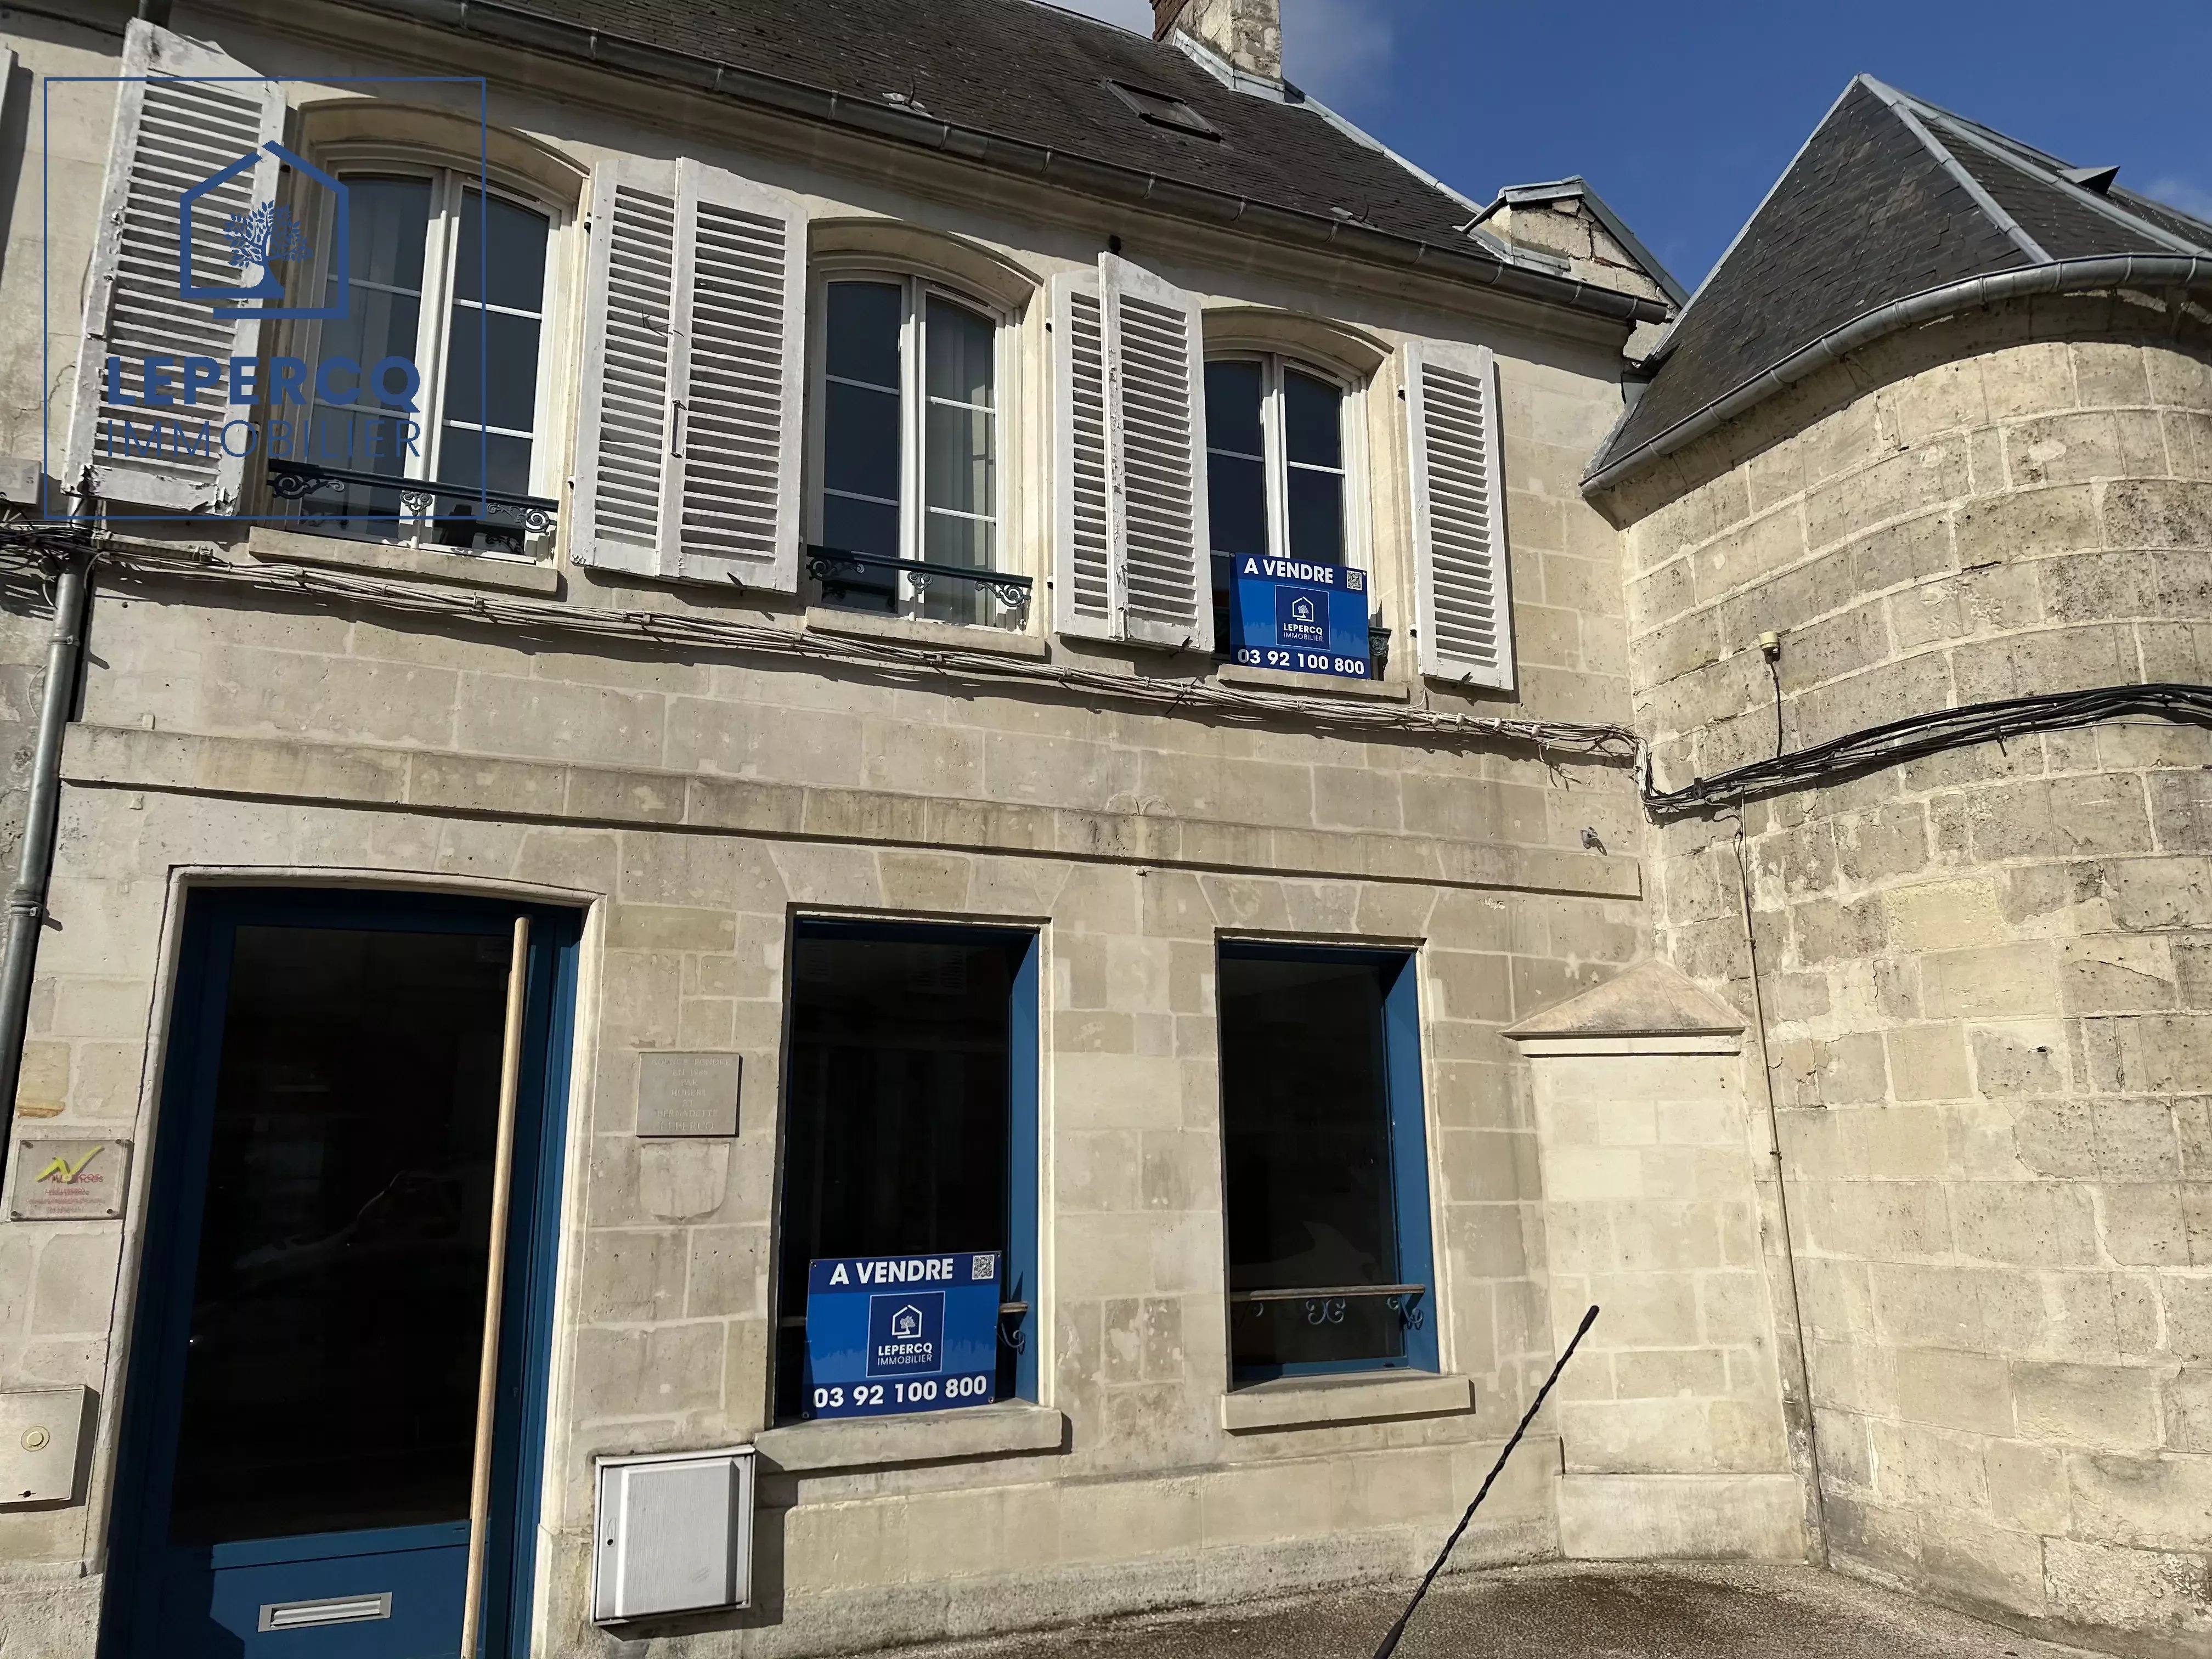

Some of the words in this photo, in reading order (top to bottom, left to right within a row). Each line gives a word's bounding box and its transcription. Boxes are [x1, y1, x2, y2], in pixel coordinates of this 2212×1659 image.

[1244, 558, 1259, 574] A
[1262, 559, 1333, 584] VENDRE
[1283, 623, 1323, 636] LEPERCQ
[1284, 632, 1323, 642] IMMOBILIER
[1238, 649, 1261, 663] 03
[1267, 651, 1290, 666] 92
[1297, 653, 1328, 670] 100
[1334, 659, 1364, 675] 800
[829, 1263, 849, 1285] A
[856, 1259, 953, 1284] VENDRE
[878, 1342, 932, 1356] LEPERCQ
[878, 1353, 932, 1365] IMMOBILIER
[813, 1387, 844, 1408] 03
[853, 1385, 884, 1406] 92
[895, 1381, 937, 1402] 100
[945, 1375, 986, 1398] 800
